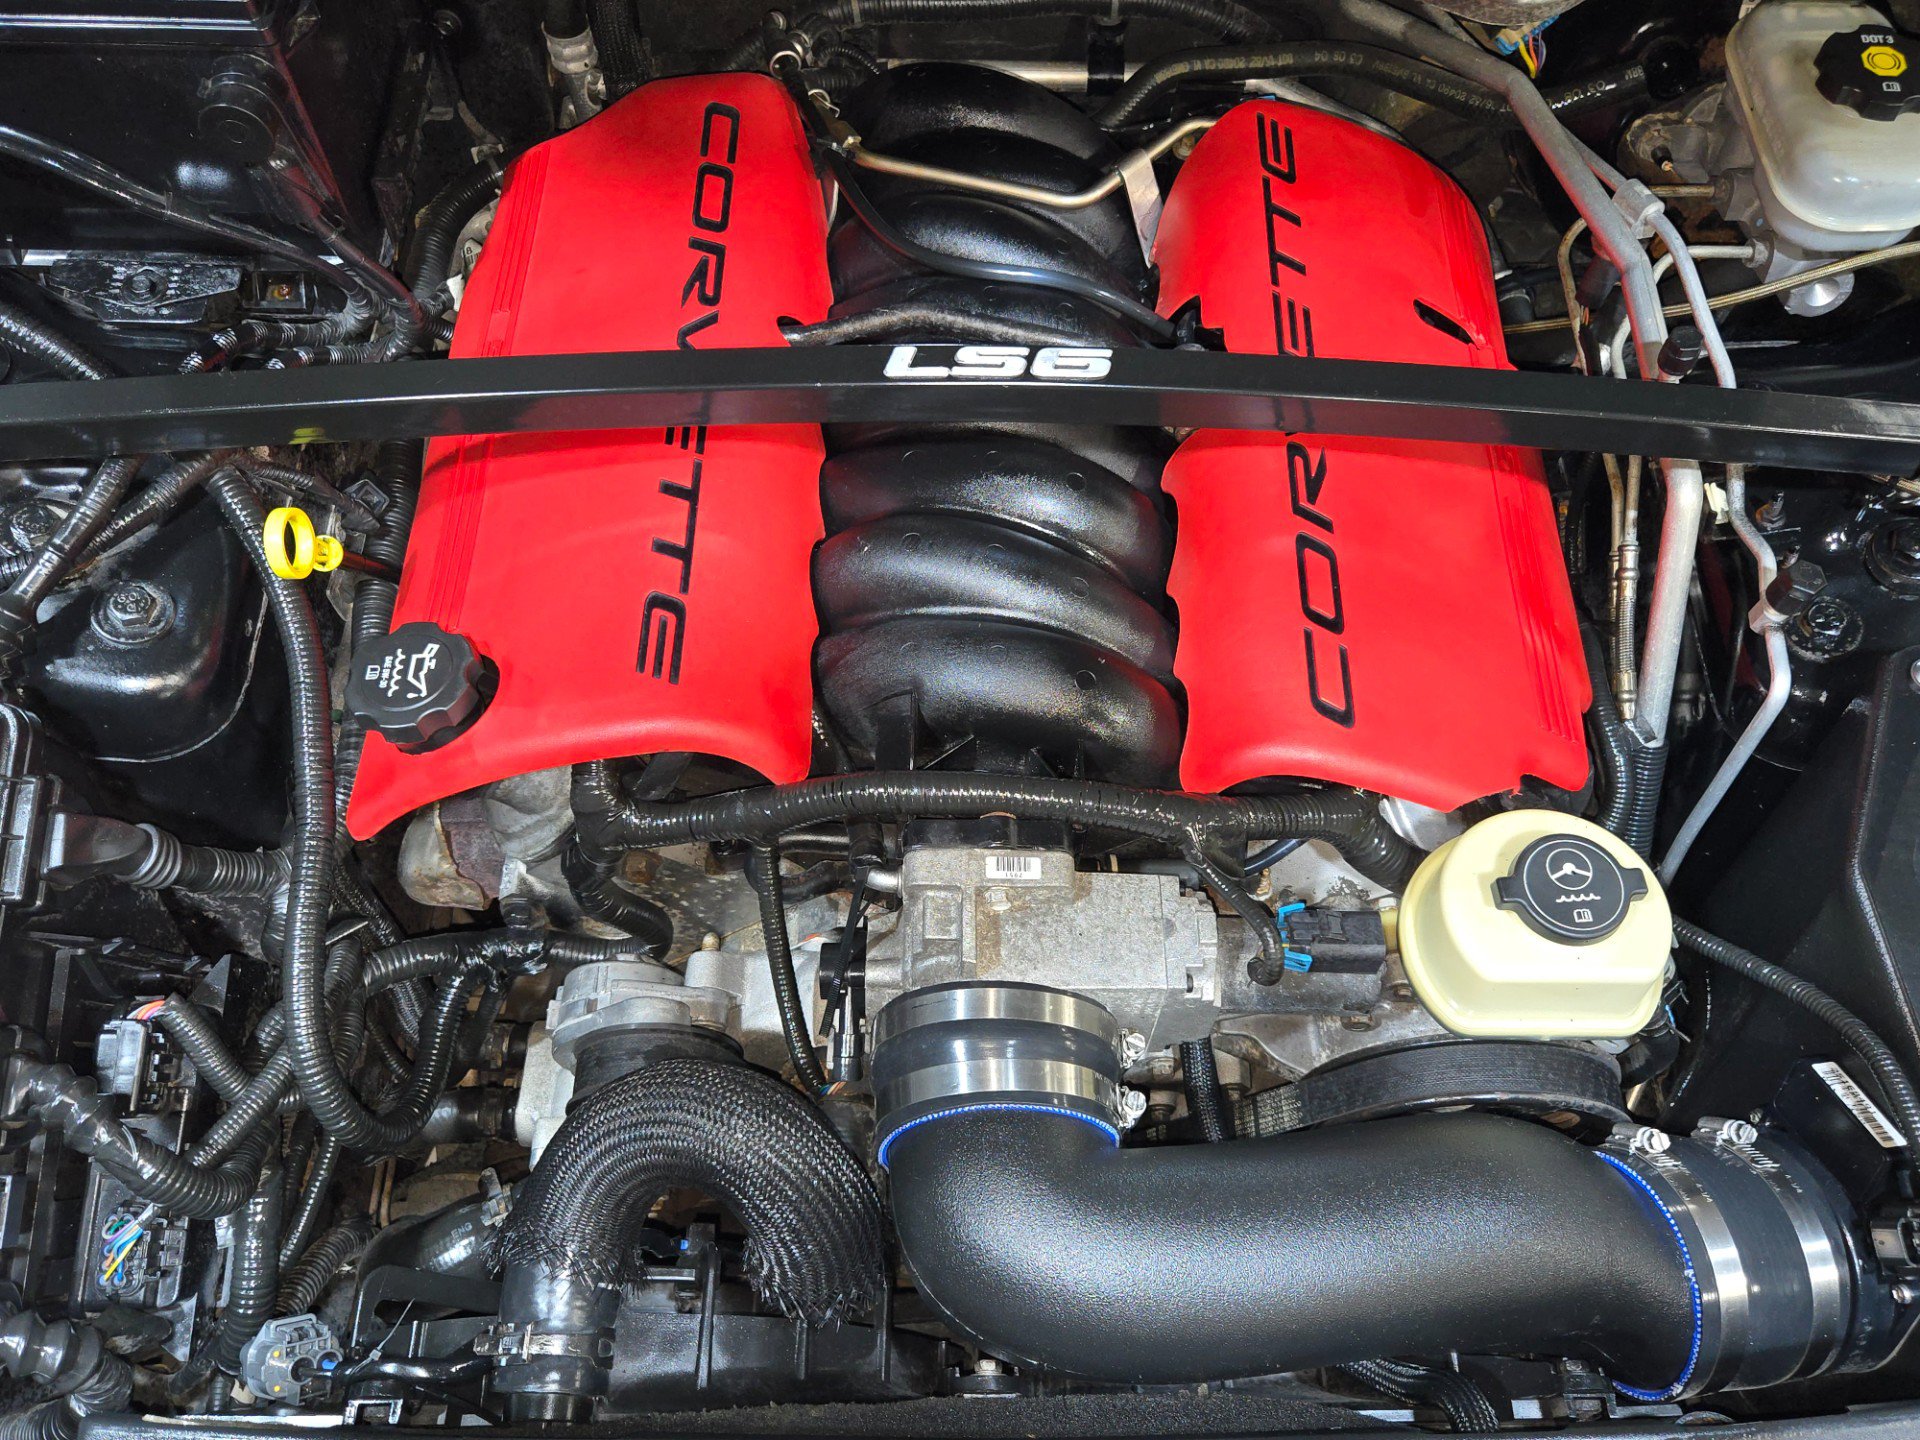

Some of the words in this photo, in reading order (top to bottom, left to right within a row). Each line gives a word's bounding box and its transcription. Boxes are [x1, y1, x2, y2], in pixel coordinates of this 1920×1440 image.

[1860, 34, 1884, 44] DOT
[1885, 34, 1895, 44] 3
[883, 345, 1114, 380] LS6
[1257, 111, 1356, 729] CORETTE
